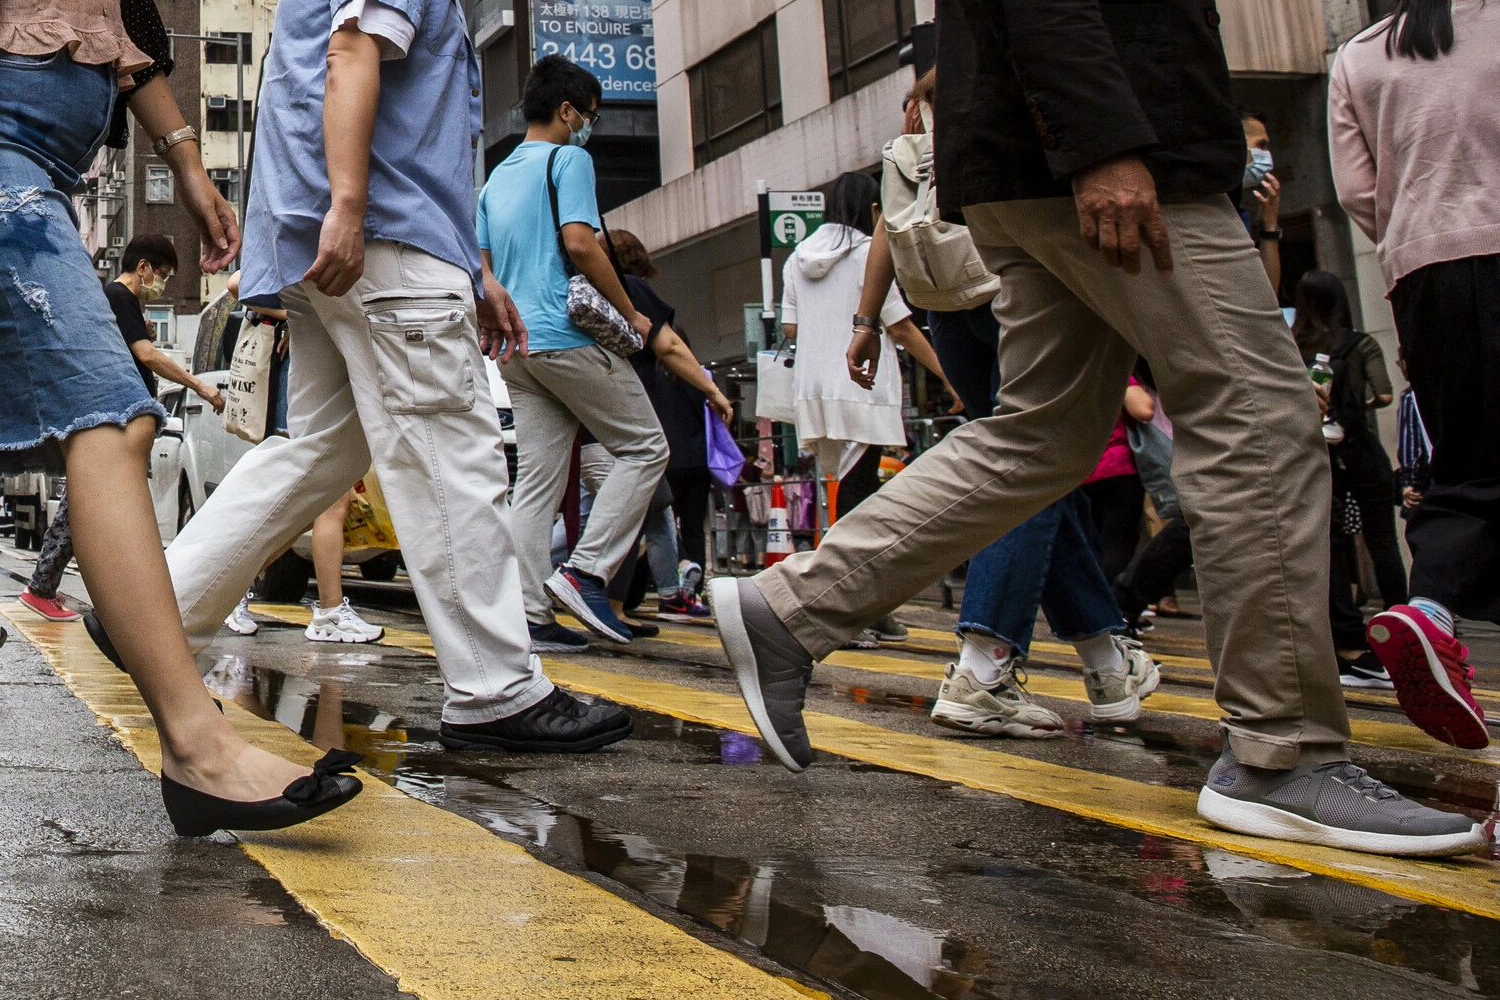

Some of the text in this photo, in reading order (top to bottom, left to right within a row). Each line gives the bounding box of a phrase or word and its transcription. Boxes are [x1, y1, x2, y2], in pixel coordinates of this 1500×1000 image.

[583, 4, 610, 18] 138
[540, 20, 562, 33] TO
[566, 21, 632, 35] ENQUIRE
